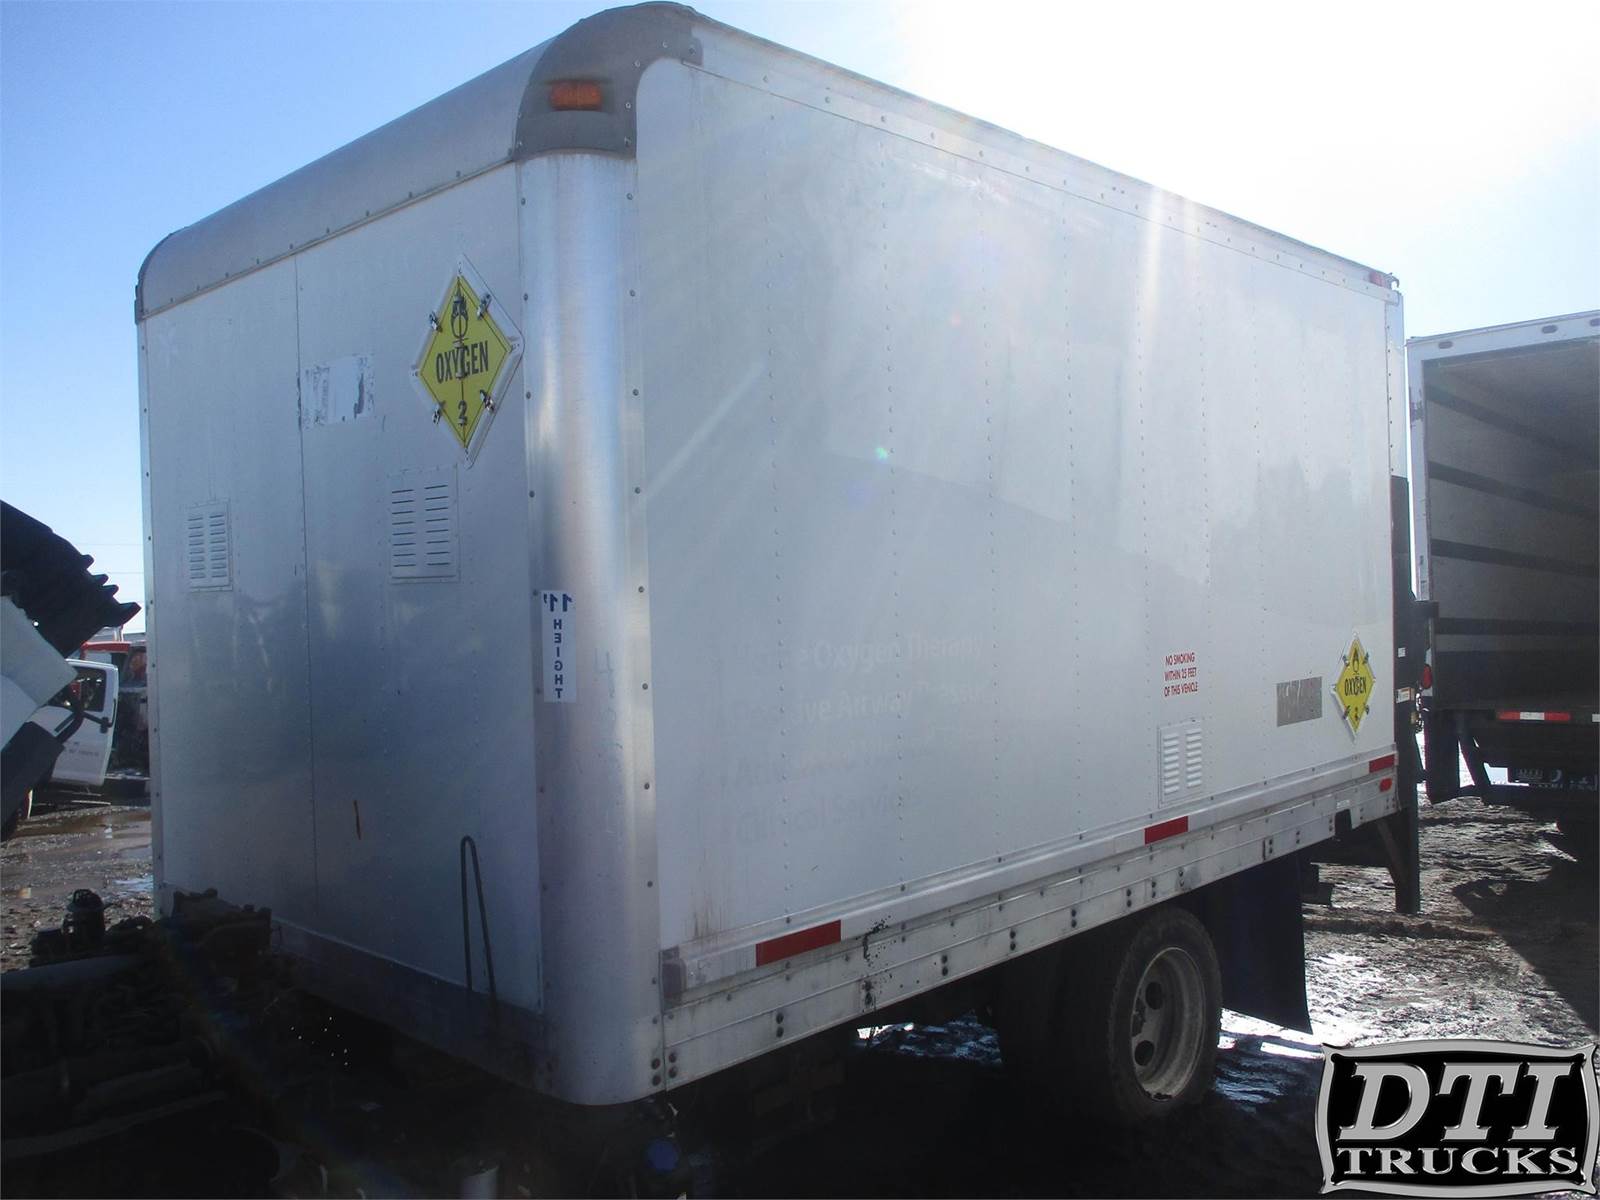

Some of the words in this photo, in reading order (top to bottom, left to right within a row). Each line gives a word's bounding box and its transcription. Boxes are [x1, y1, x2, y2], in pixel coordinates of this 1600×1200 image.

[436, 341, 489, 383] OXYGEN
[458, 400, 467, 423] 2
[1165, 655, 1173, 666] NO
[1173, 652, 1195, 665] SMOKING
[1164, 670, 1181, 682] WITHIN
[1188, 667, 1197, 678] FEET
[1164, 686, 1170, 697] OF
[1171, 684, 1181, 696] THIS
[1181, 682, 1198, 694] VEHICLE
[1344, 675, 1367, 697] OXYGEN
